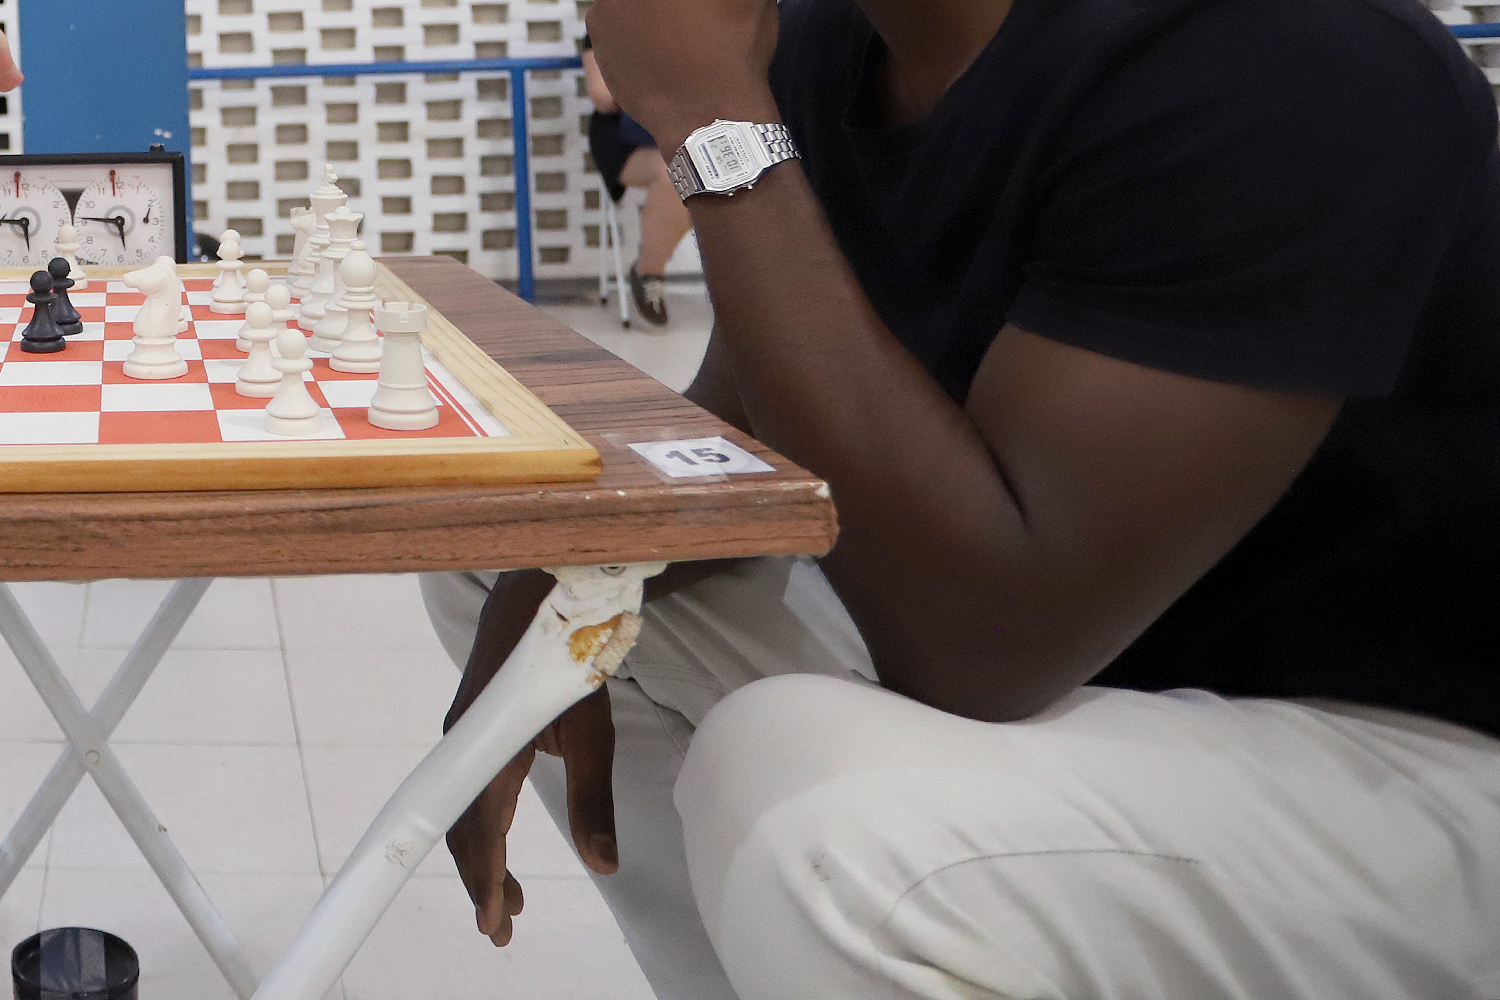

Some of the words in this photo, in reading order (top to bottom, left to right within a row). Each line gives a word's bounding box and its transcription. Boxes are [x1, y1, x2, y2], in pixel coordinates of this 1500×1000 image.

[720, 145, 739, 169] 10:36
[54, 201, 59, 209] 2
[85, 201, 95, 209] 10
[148, 200, 154, 208] 2
[101, 249, 107, 257] 7
[23, 256, 30, 264] 6
[117, 255, 124, 263] 6
[664, 447, 731, 466] 15
